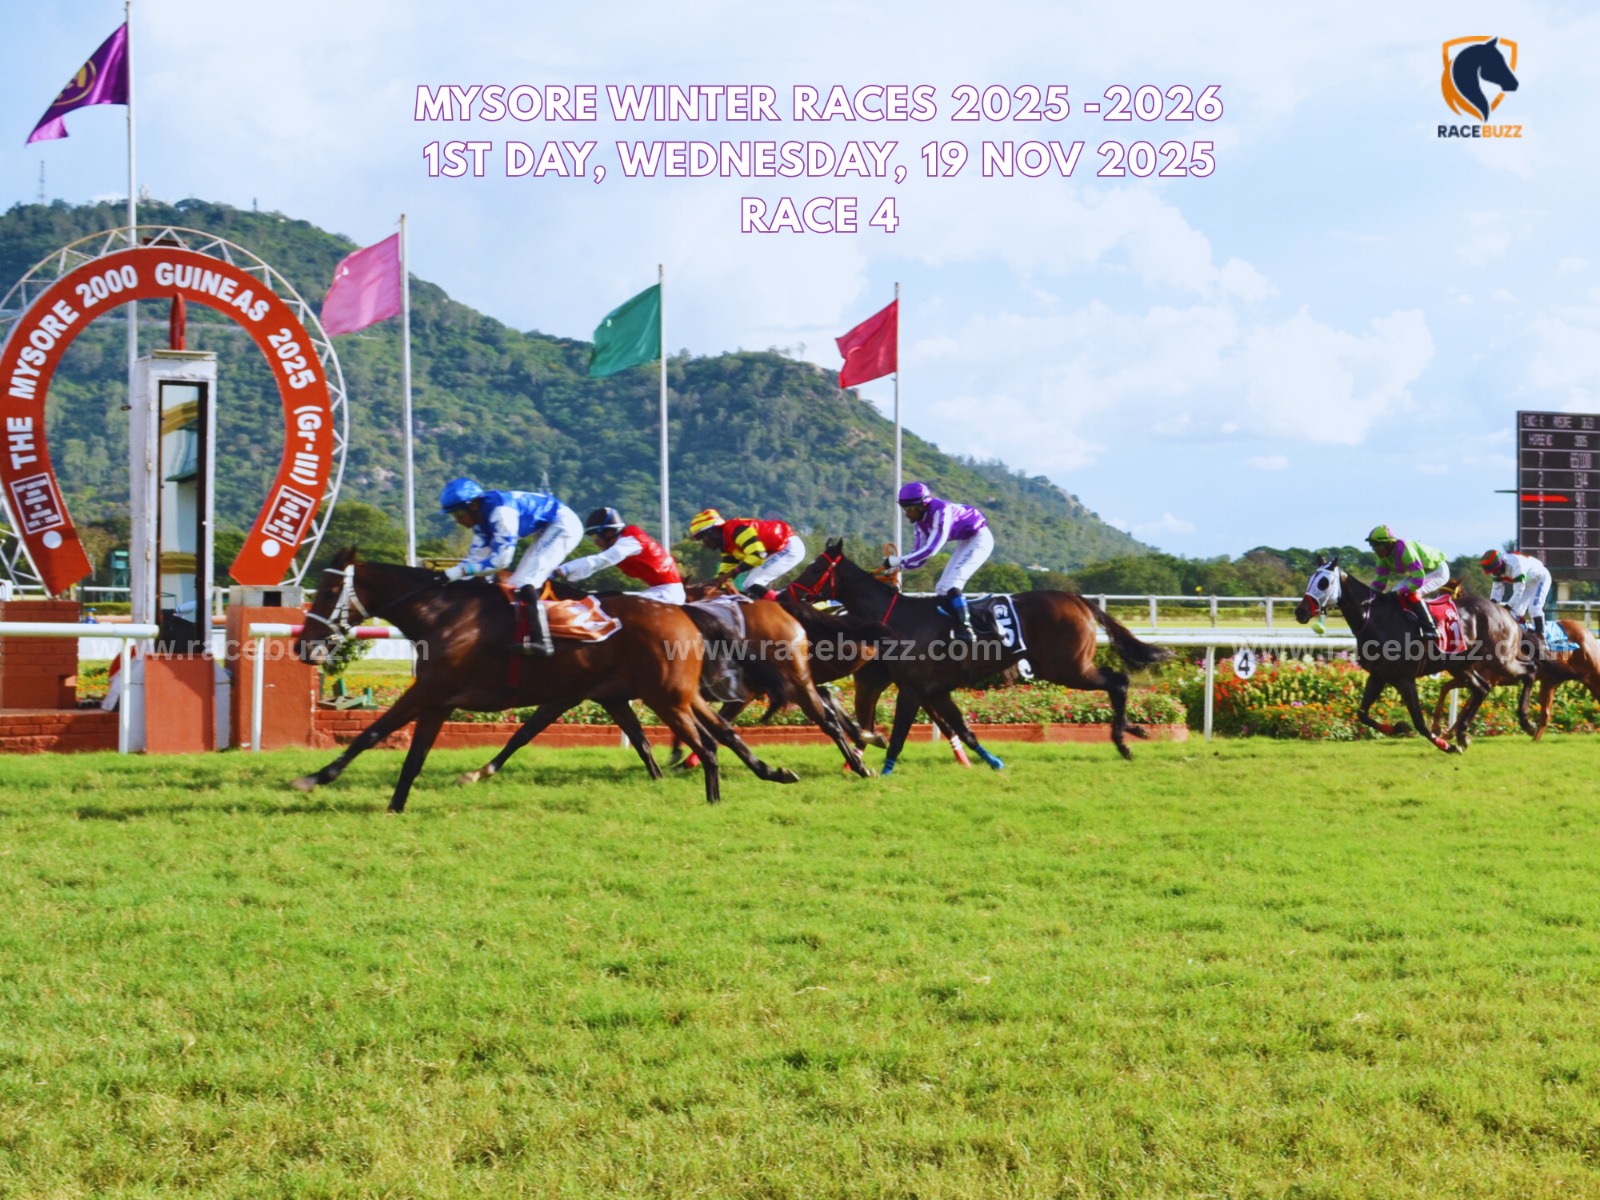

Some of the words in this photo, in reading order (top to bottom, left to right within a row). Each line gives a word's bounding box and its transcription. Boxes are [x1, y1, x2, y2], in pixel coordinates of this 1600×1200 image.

[75, 264, 138, 308] 2000
[155, 262, 270, 322] GUINEAS
[8, 299, 79, 400] MYSORE
[267, 327, 317, 389] 2025
[7, 416, 37, 470] THE
[290, 405, 323, 486] (Gr-III)
[1238, 652, 1250, 676] 4
